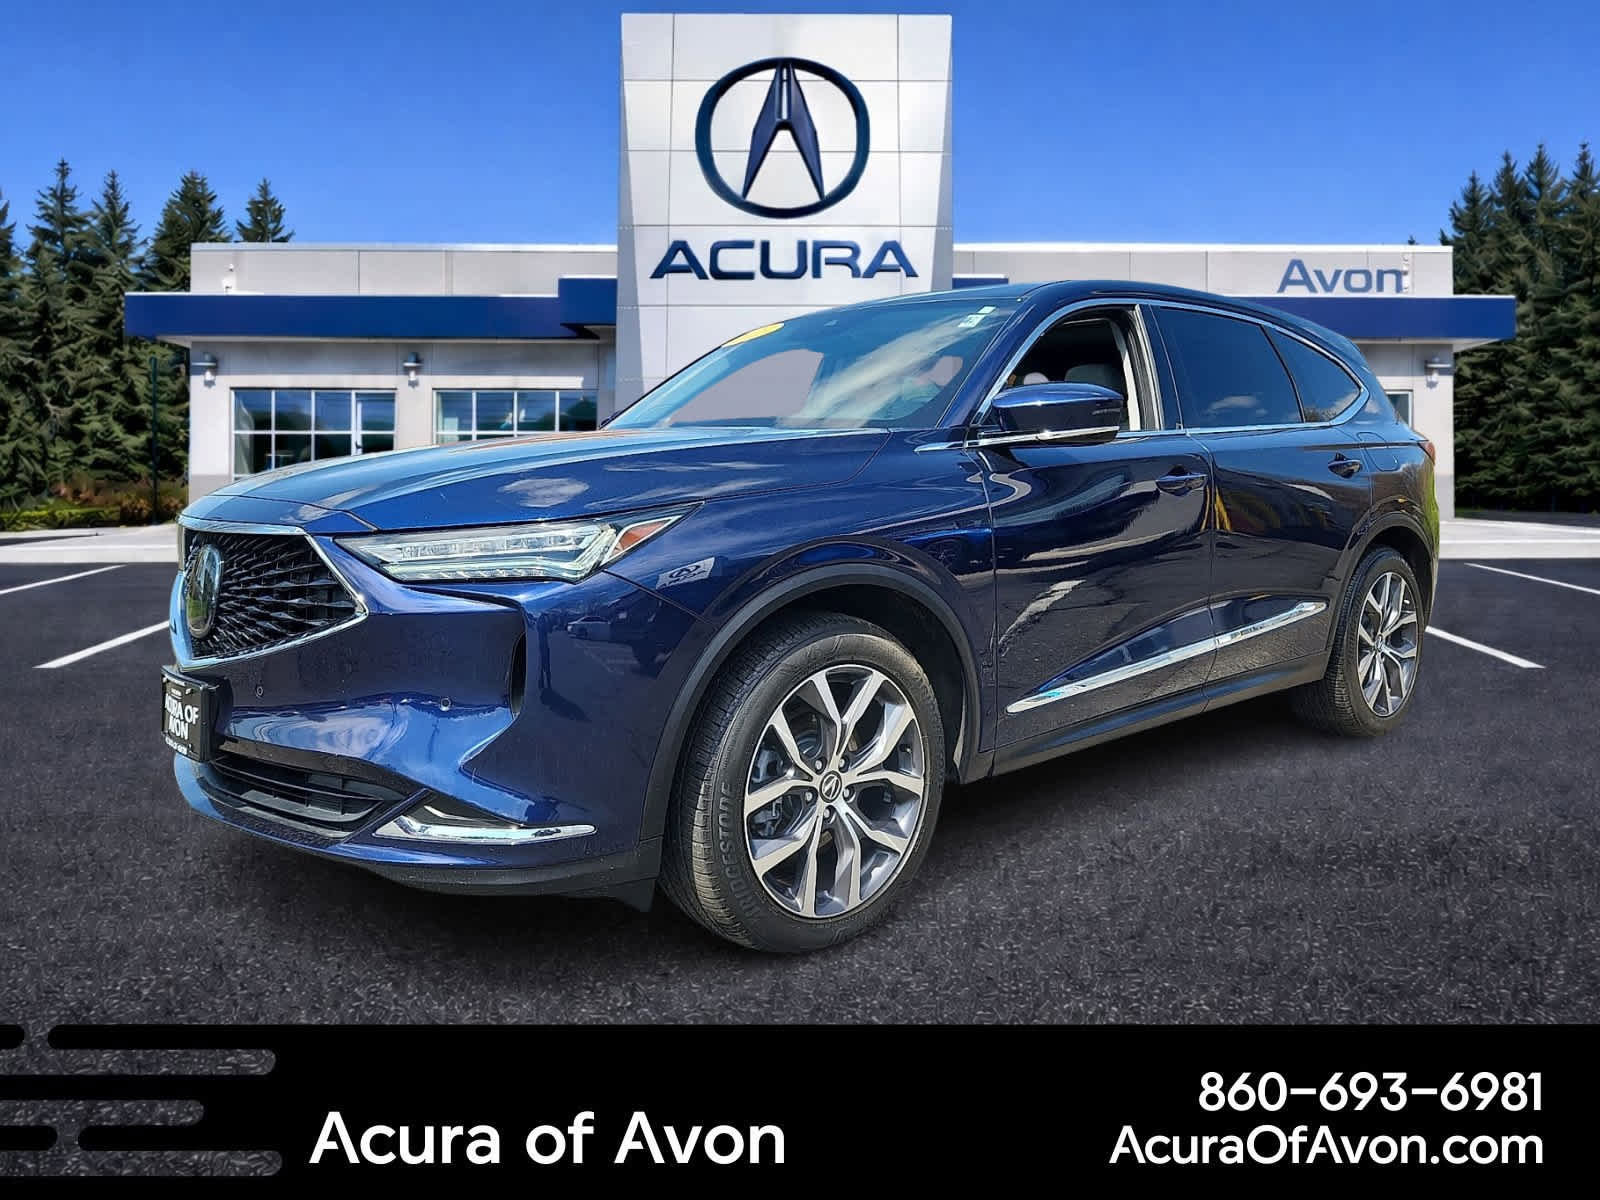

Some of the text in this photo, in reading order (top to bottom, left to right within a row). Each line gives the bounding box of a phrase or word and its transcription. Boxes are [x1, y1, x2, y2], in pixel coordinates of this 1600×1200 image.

[650, 240, 919, 280] ACURA
[1277, 259, 1404, 293] Avon
[184, 704, 199, 724] OF
